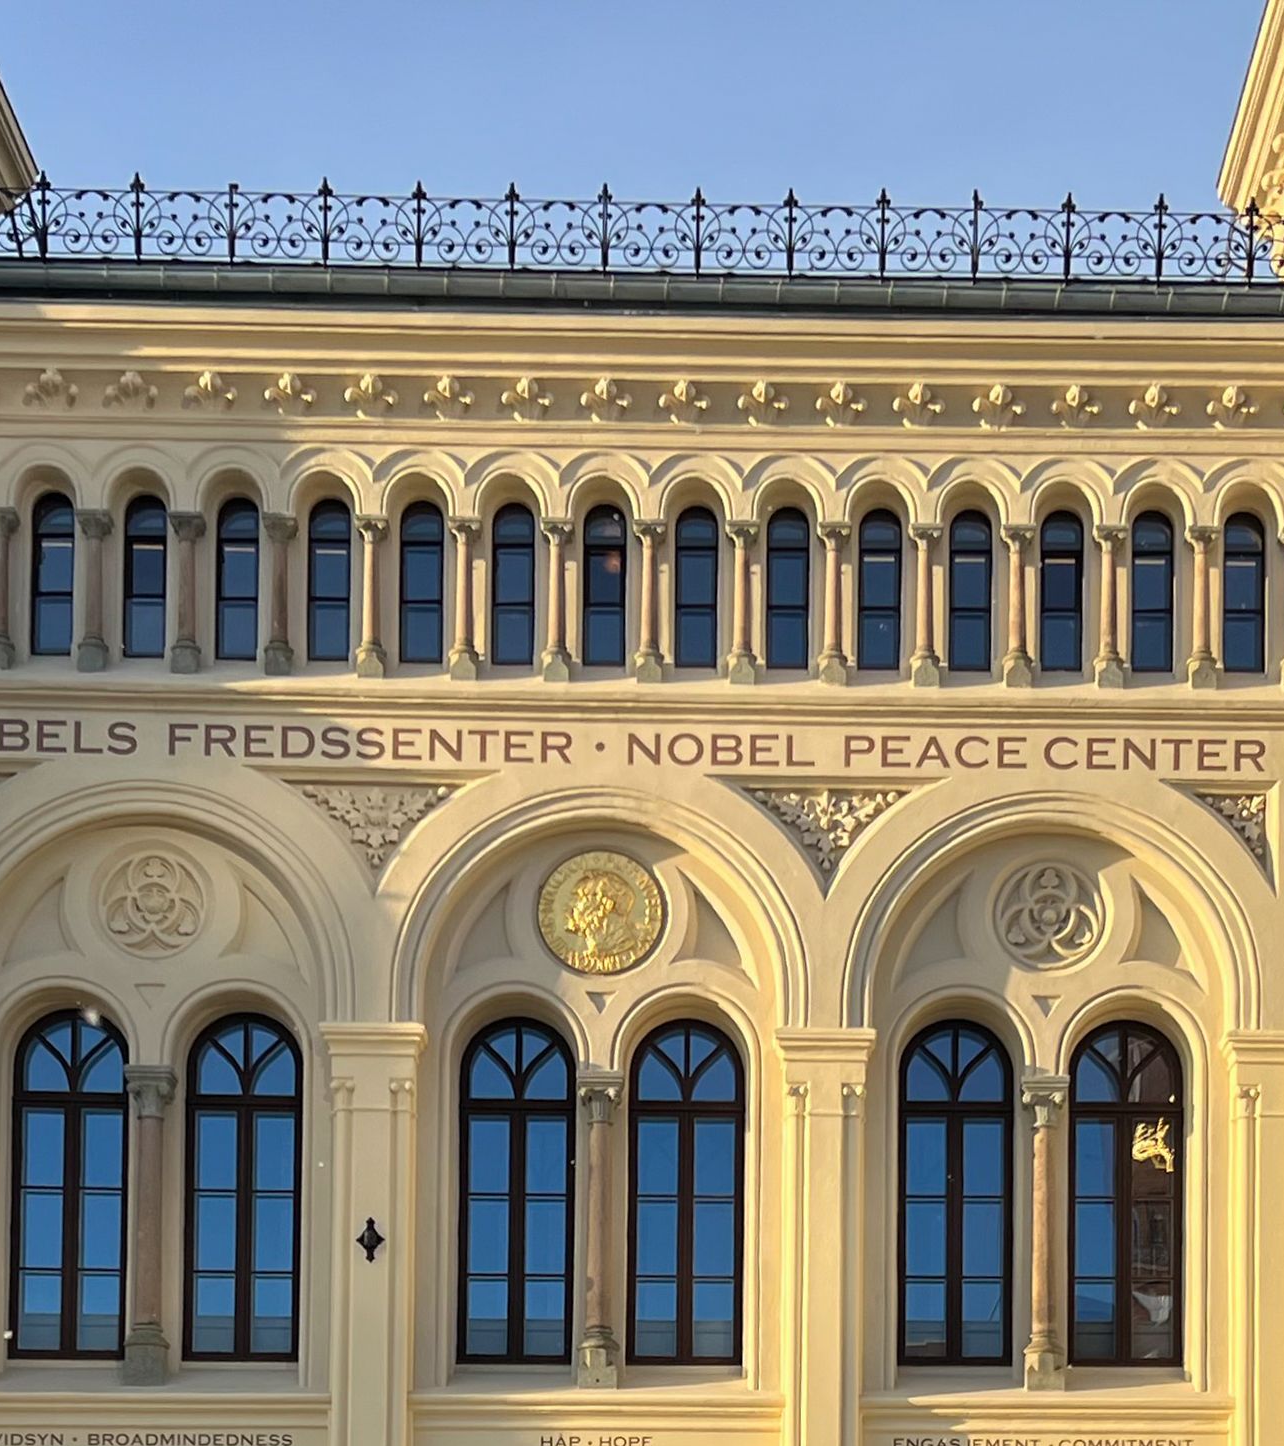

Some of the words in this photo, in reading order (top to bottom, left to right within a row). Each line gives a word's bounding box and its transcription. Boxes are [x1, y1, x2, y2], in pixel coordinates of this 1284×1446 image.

[168, 723, 573, 764] FREDSSENTER
[627, 733, 815, 767] NOBEL
[844, 735, 1028, 770] PEACE
[1043, 737, 1267, 772] CENTER
[87, 1433, 293, 1446] BROADMINDEDNESS
